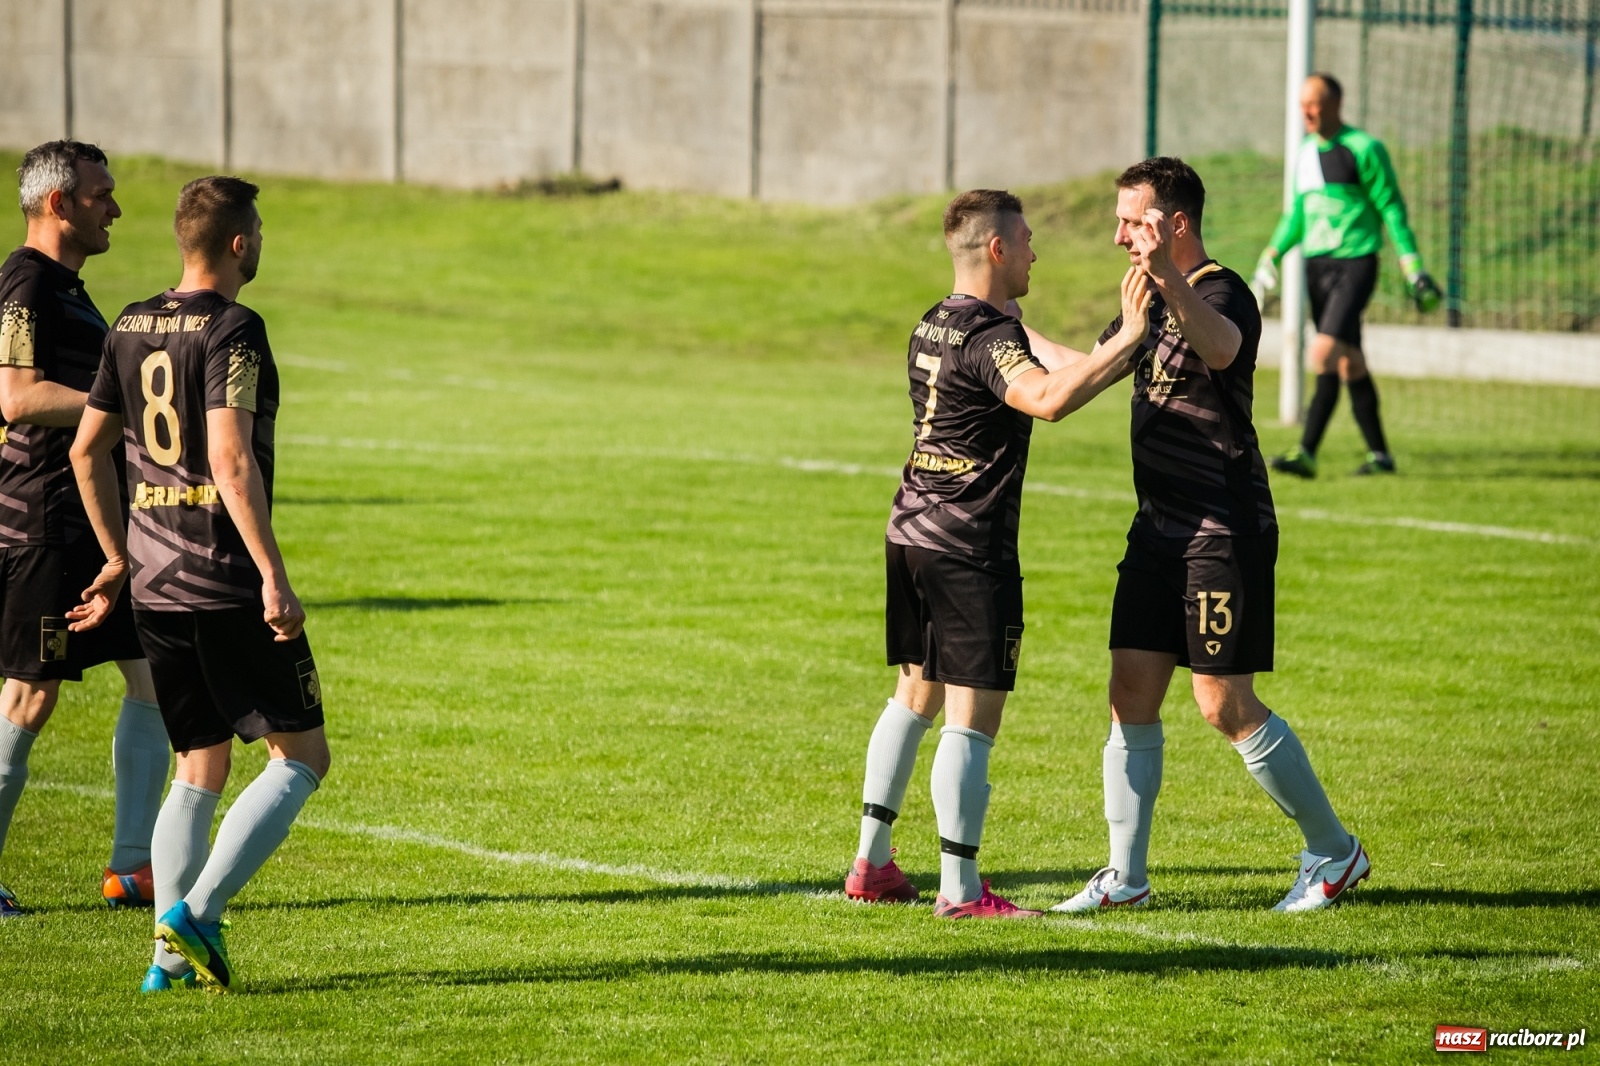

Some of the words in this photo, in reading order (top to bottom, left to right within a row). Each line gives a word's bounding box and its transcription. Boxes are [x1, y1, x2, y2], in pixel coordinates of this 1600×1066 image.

[116, 314, 153, 333] CZARNI
[140, 350, 182, 467] 8
[915, 352, 942, 440] 7
[1197, 591, 1233, 635] 13
